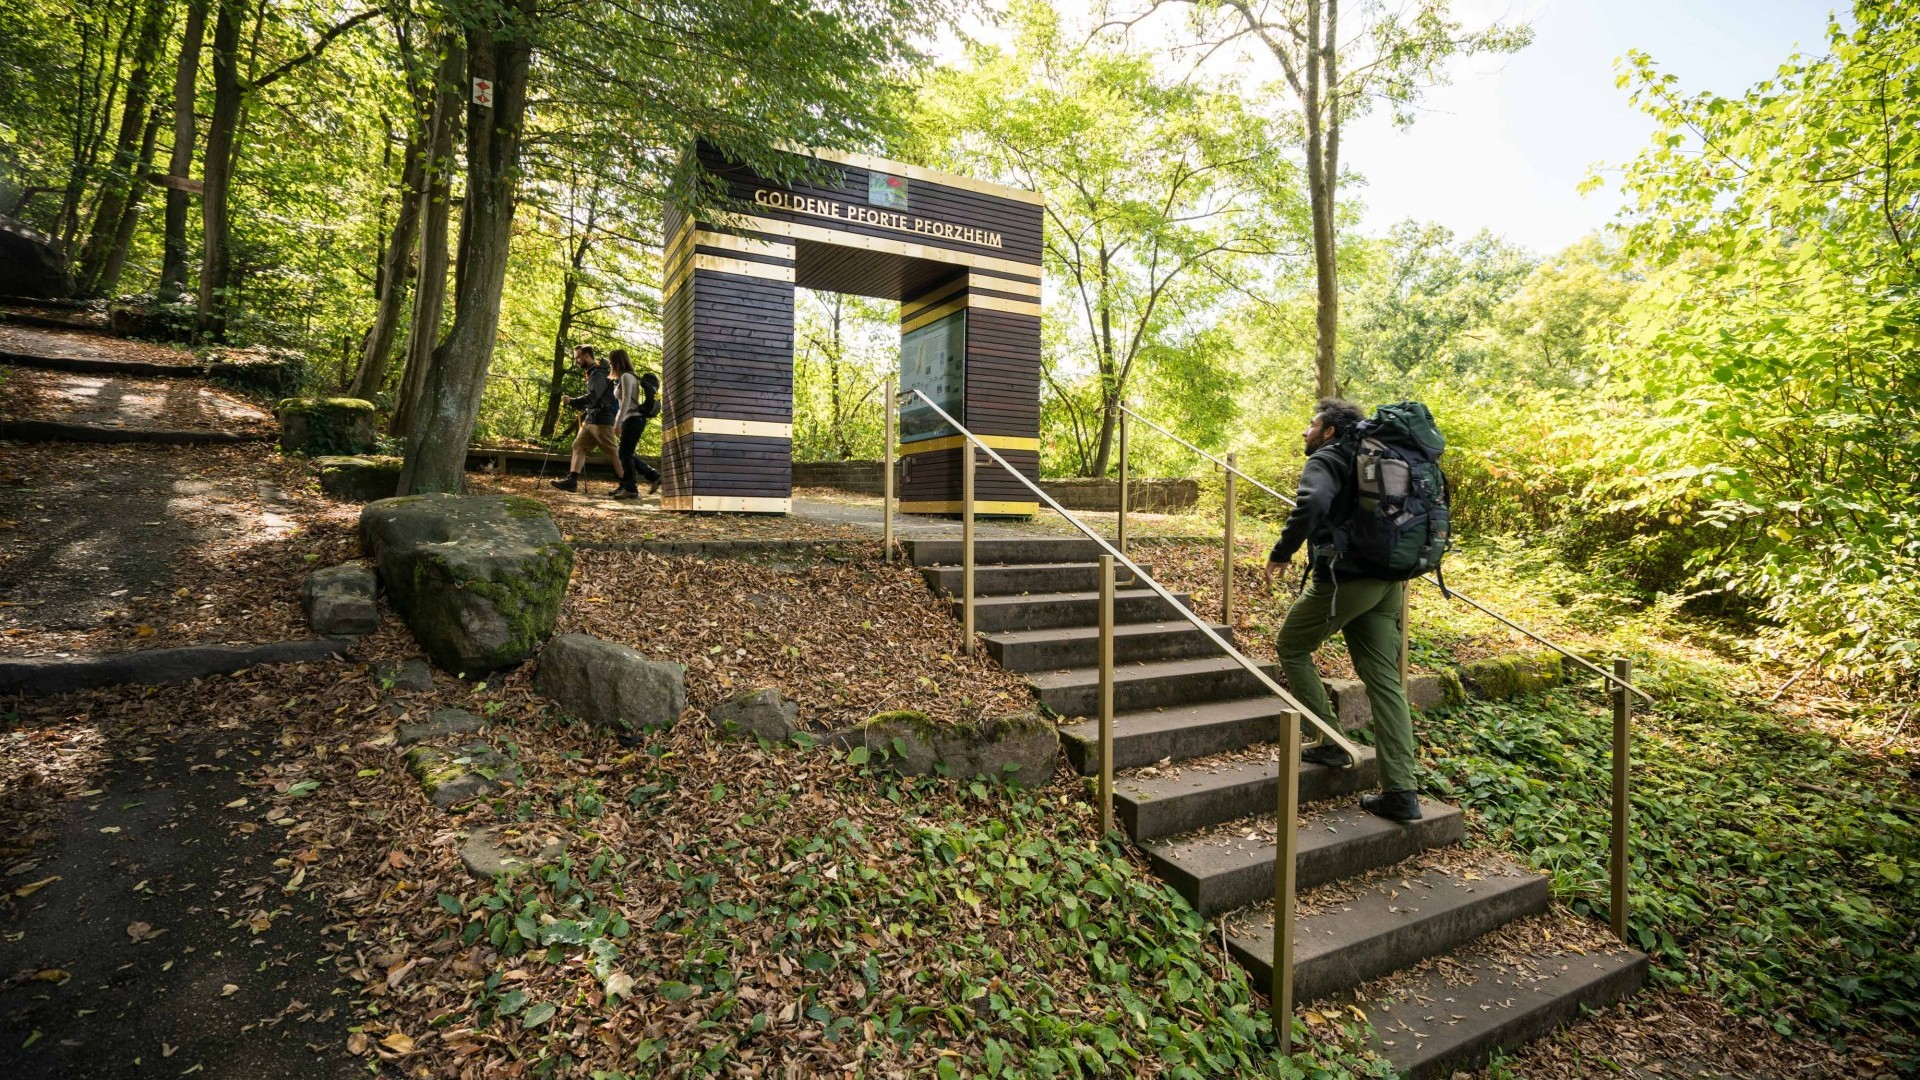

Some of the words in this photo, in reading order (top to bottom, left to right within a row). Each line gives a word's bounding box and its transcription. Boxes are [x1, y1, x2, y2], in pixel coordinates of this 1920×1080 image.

[754, 189, 840, 217] GOLDENE
[847, 205, 908, 230] PFORTE
[914, 218, 1002, 248] PFORZHEIM
